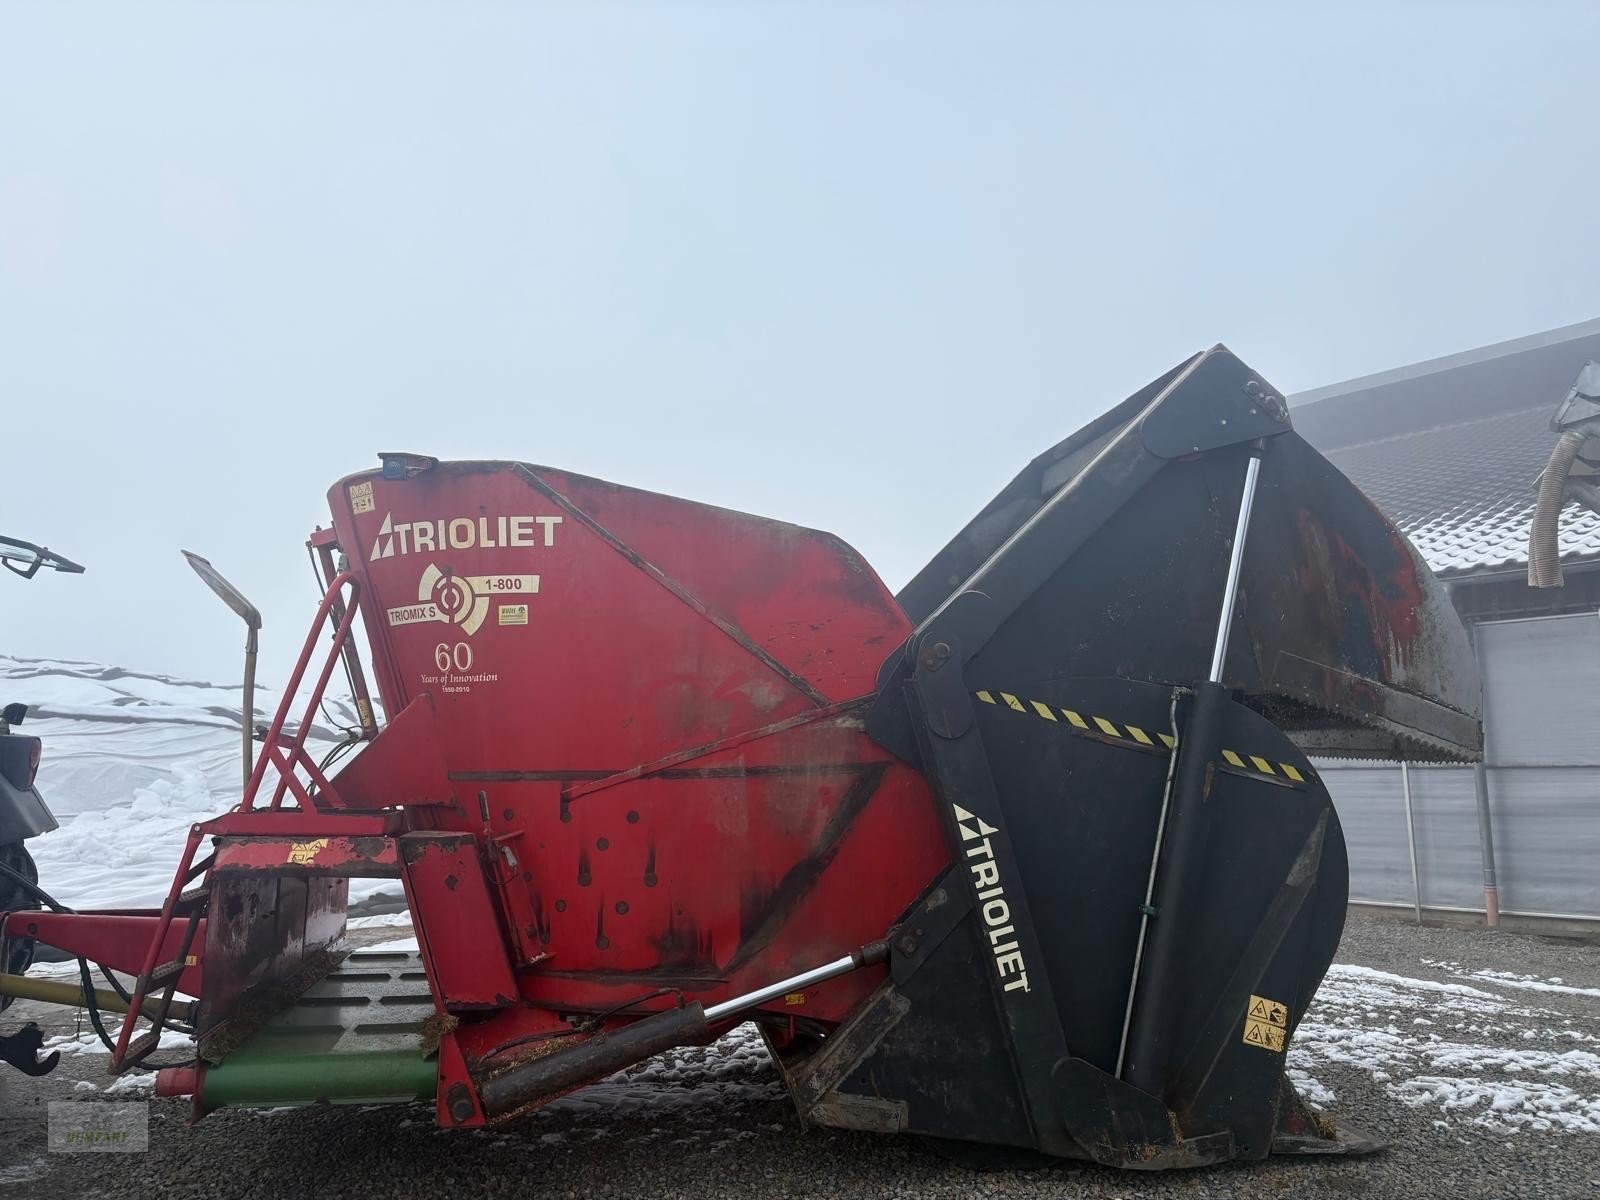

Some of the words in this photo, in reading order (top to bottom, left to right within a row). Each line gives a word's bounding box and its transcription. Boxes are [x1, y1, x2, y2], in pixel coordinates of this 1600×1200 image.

[394, 516, 563, 555] TRIOLIET
[485, 578, 522, 591] 1-800
[390, 608, 427, 623] TRIOMIX
[429, 606, 436, 618] S
[435, 642, 473, 672] 60
[421, 674, 439, 684] Years
[440, 671, 448, 687] of
[450, 672, 498, 683] Innovation
[966, 837, 1029, 993] TRIOLIET
